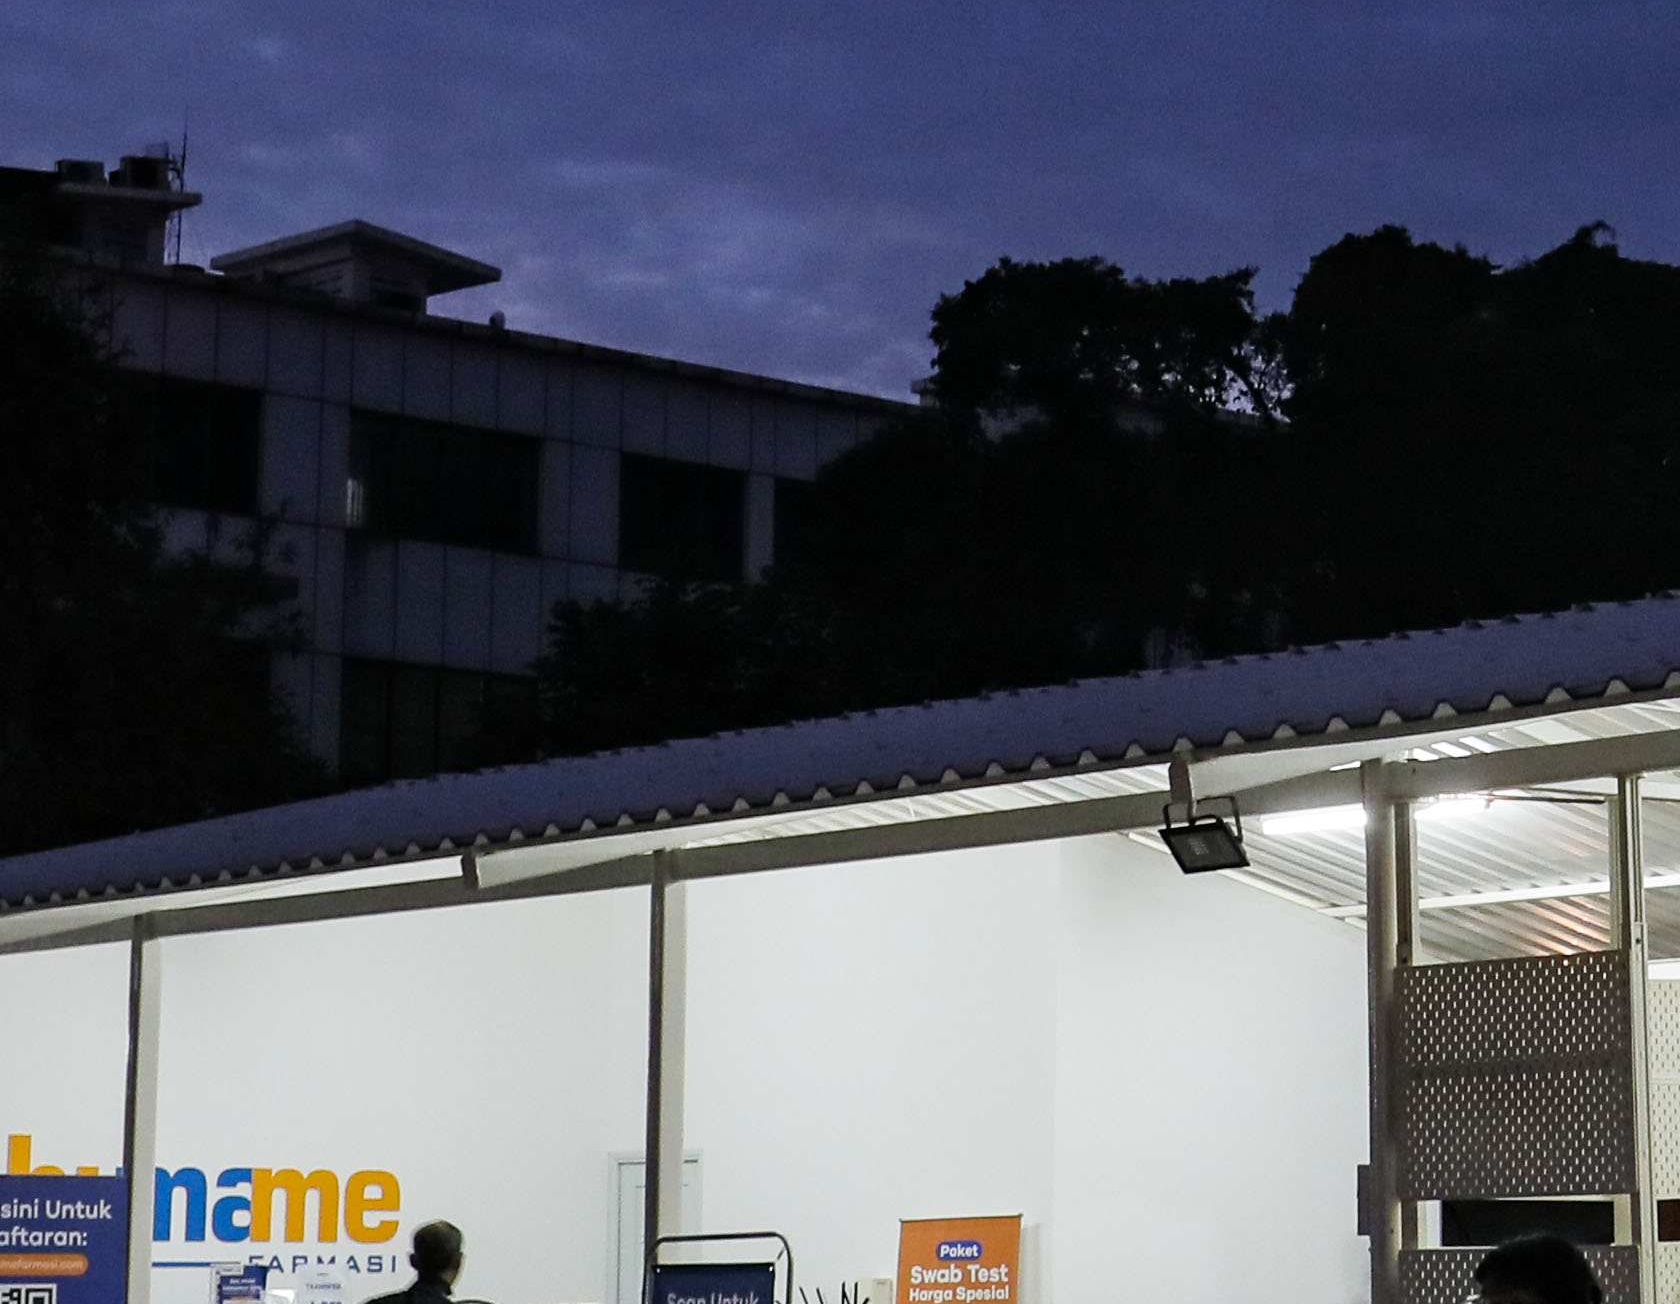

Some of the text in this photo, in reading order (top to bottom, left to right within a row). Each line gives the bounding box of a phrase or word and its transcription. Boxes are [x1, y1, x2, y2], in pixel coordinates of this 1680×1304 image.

[45, 1198, 112, 1220] Untuk
[939, 1243, 980, 1259] Paket
[910, 1263, 1009, 1284] Swab Test
[909, 1285, 1010, 1304] Harga Spesial
